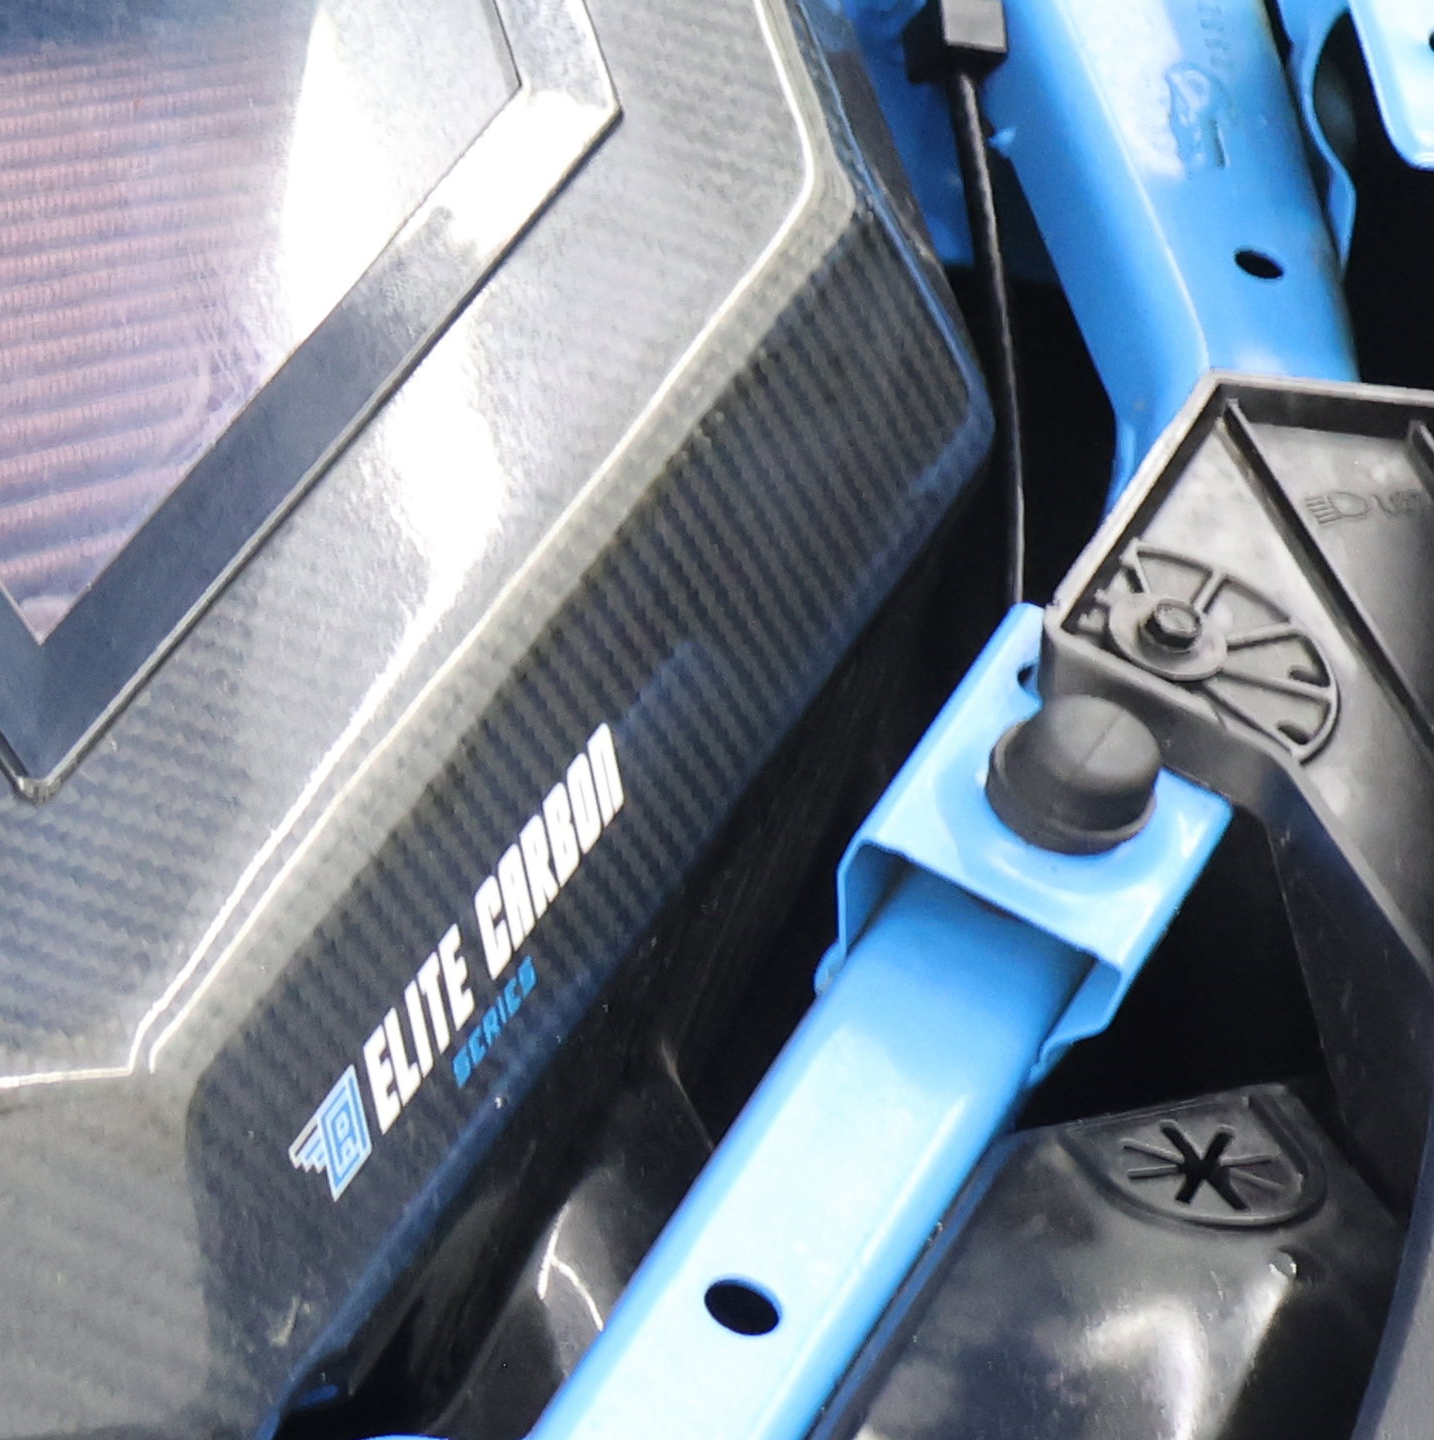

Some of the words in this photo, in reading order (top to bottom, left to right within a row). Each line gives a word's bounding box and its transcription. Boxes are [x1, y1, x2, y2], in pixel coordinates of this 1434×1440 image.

[363, 923, 475, 1136] ELITE
[473, 721, 625, 981] CARBON
[450, 954, 538, 1089] SERIES
